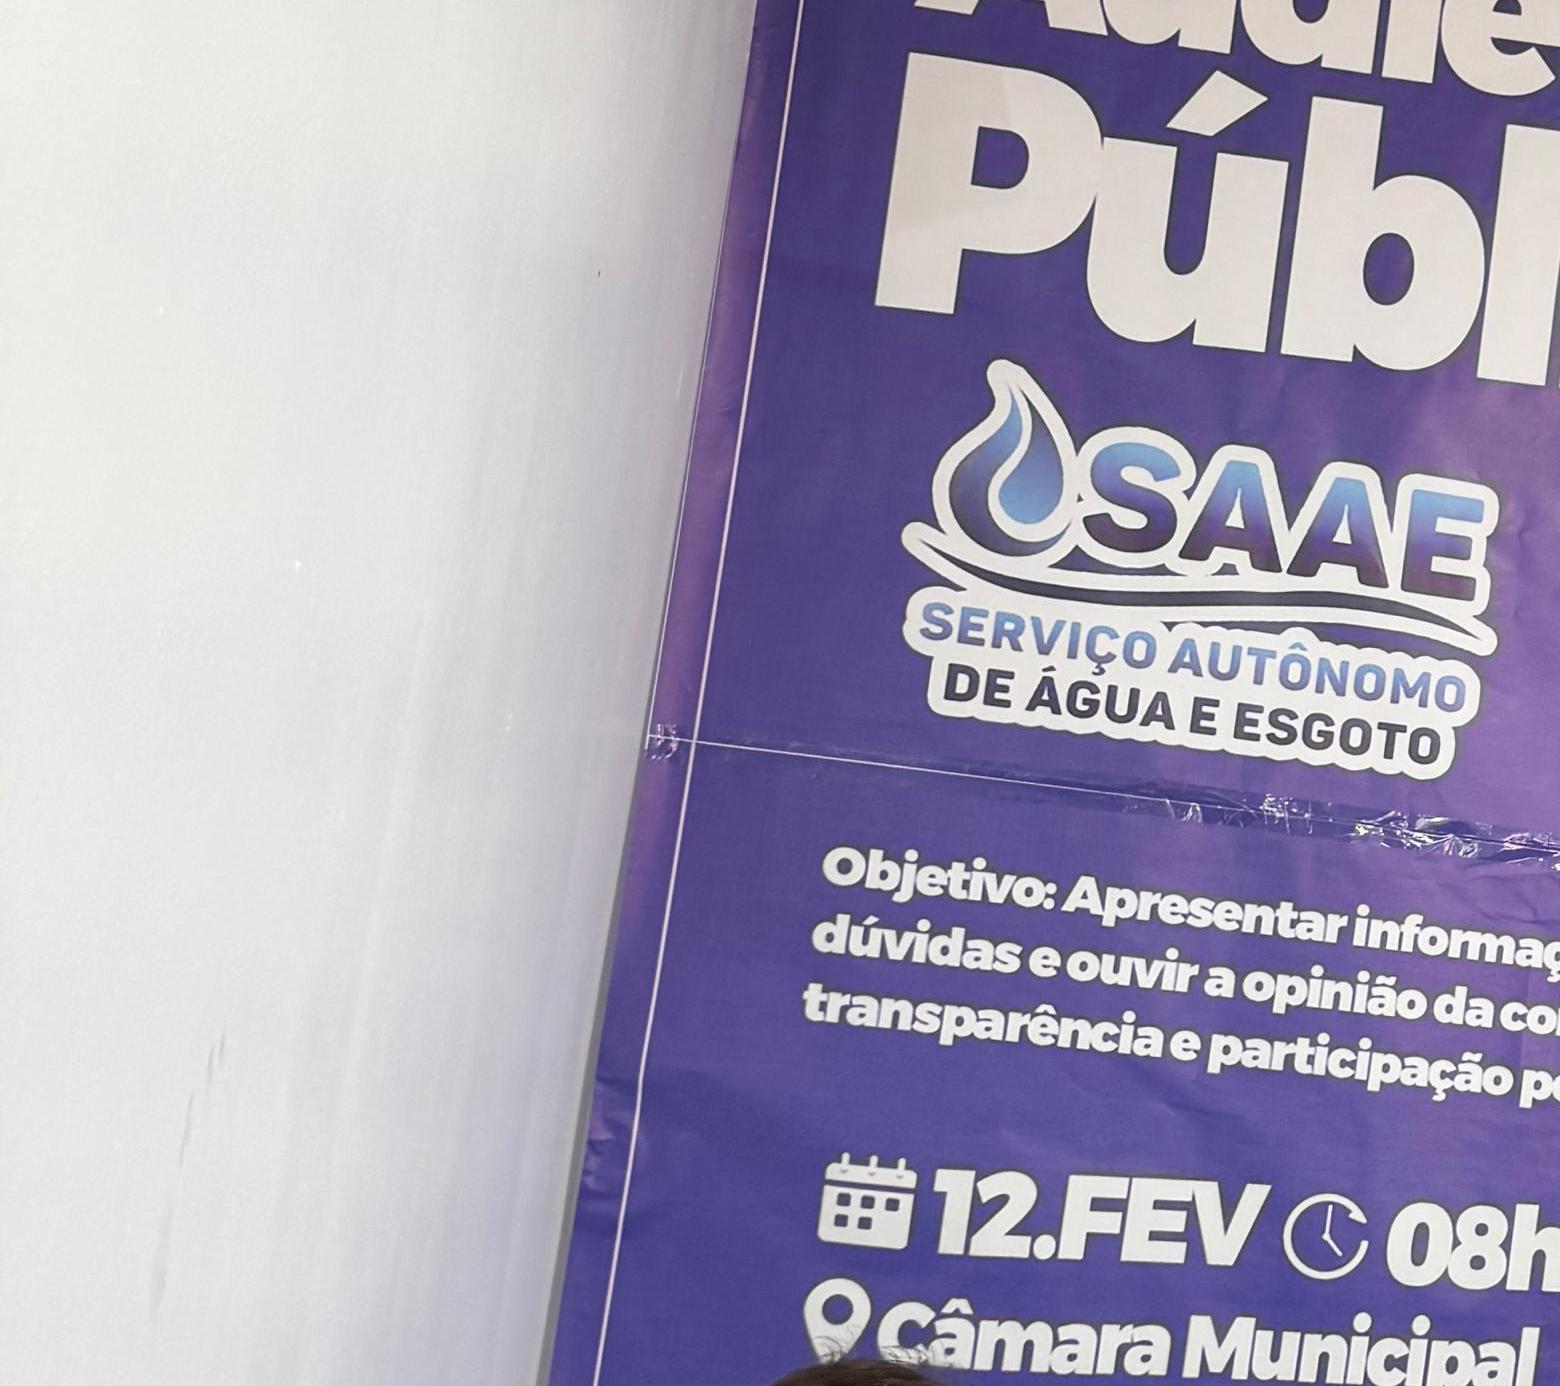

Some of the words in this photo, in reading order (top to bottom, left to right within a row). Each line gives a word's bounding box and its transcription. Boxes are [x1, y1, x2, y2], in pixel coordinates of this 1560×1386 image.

[1081, 442, 1486, 600] SAAE
[919, 602, 1156, 676] SERVIÇO
[1167, 638, 1466, 713] AUTÔNOMO
[943, 663, 1013, 708] DE
[1025, 667, 1175, 732] ÁGUA
[1192, 697, 1220, 735] E
[1232, 703, 1441, 765] ESGOTO
[821, 845, 1056, 910] Objetivo:
[1061, 875, 1347, 943] Apresentar
[811, 914, 1022, 974] dúvidas
[1028, 945, 1062, 978] e
[1066, 947, 1199, 993] ouvir
[1204, 965, 1235, 999] a
[1242, 964, 1427, 1020] opinião
[1433, 986, 1495, 1028] da
[803, 981, 1164, 1057] transparência
[1169, 1026, 1201, 1061] e
[1207, 1033, 1514, 1101] participação
[932, 1168, 1272, 1267] 12.FEV
[876, 1297, 1173, 1377] Câmara
